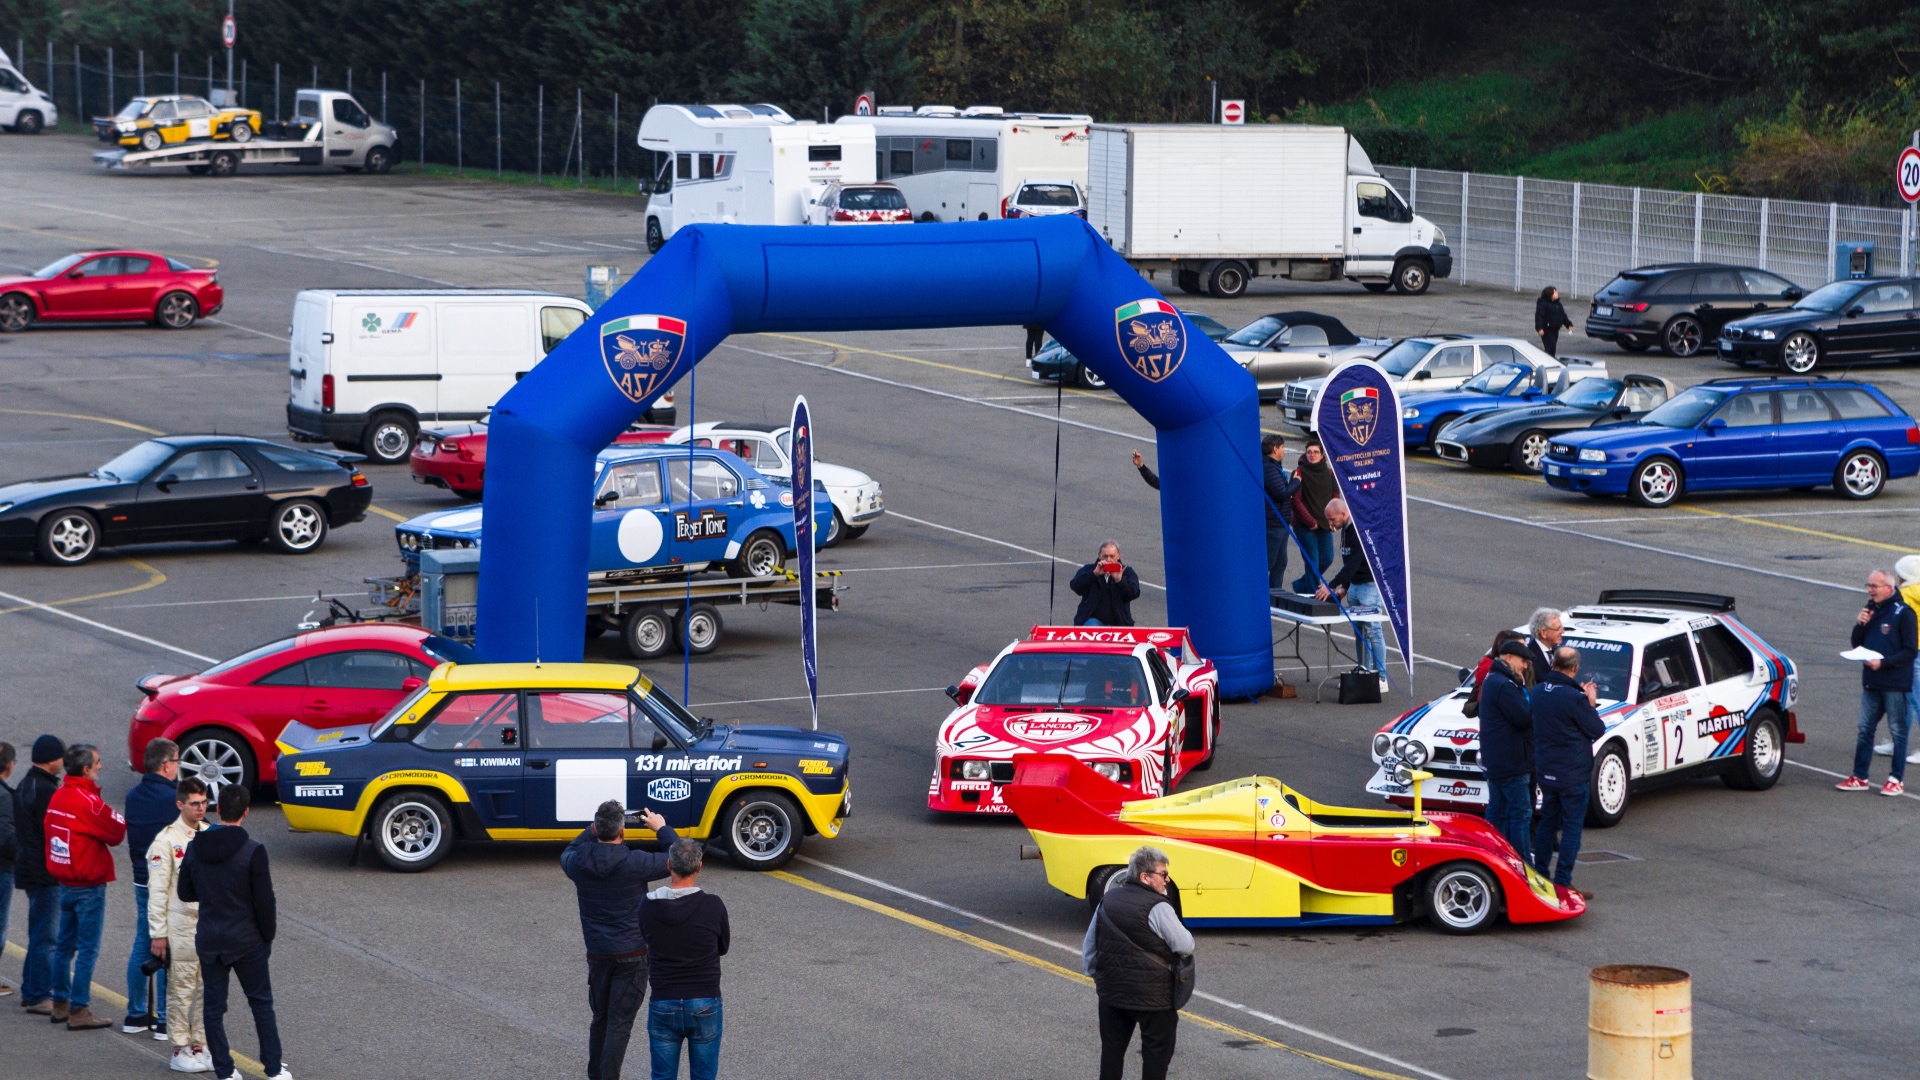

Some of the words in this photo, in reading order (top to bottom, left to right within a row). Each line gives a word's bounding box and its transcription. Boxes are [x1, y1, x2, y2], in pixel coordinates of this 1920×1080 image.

[1904, 162, 1920, 187] 20
[676, 515, 702, 539] FERNET
[703, 514, 726, 536] TONIC
[1046, 631, 1136, 642] LANCIA
[1565, 640, 1623, 653] MARTINI
[1029, 722, 1073, 730] LANCIA
[1435, 730, 1480, 739] MARTI
[954, 735, 991, 748] 2
[1674, 725, 1684, 765] 2
[480, 758, 521, 767] KIWIMAKI
[634, 755, 663, 771] 131
[665, 755, 743, 771] mirafiori
[295, 784, 344, 797] PIRELLI
[951, 781, 991, 790] PIRELLI
[1439, 785, 1480, 795] MARTINI
